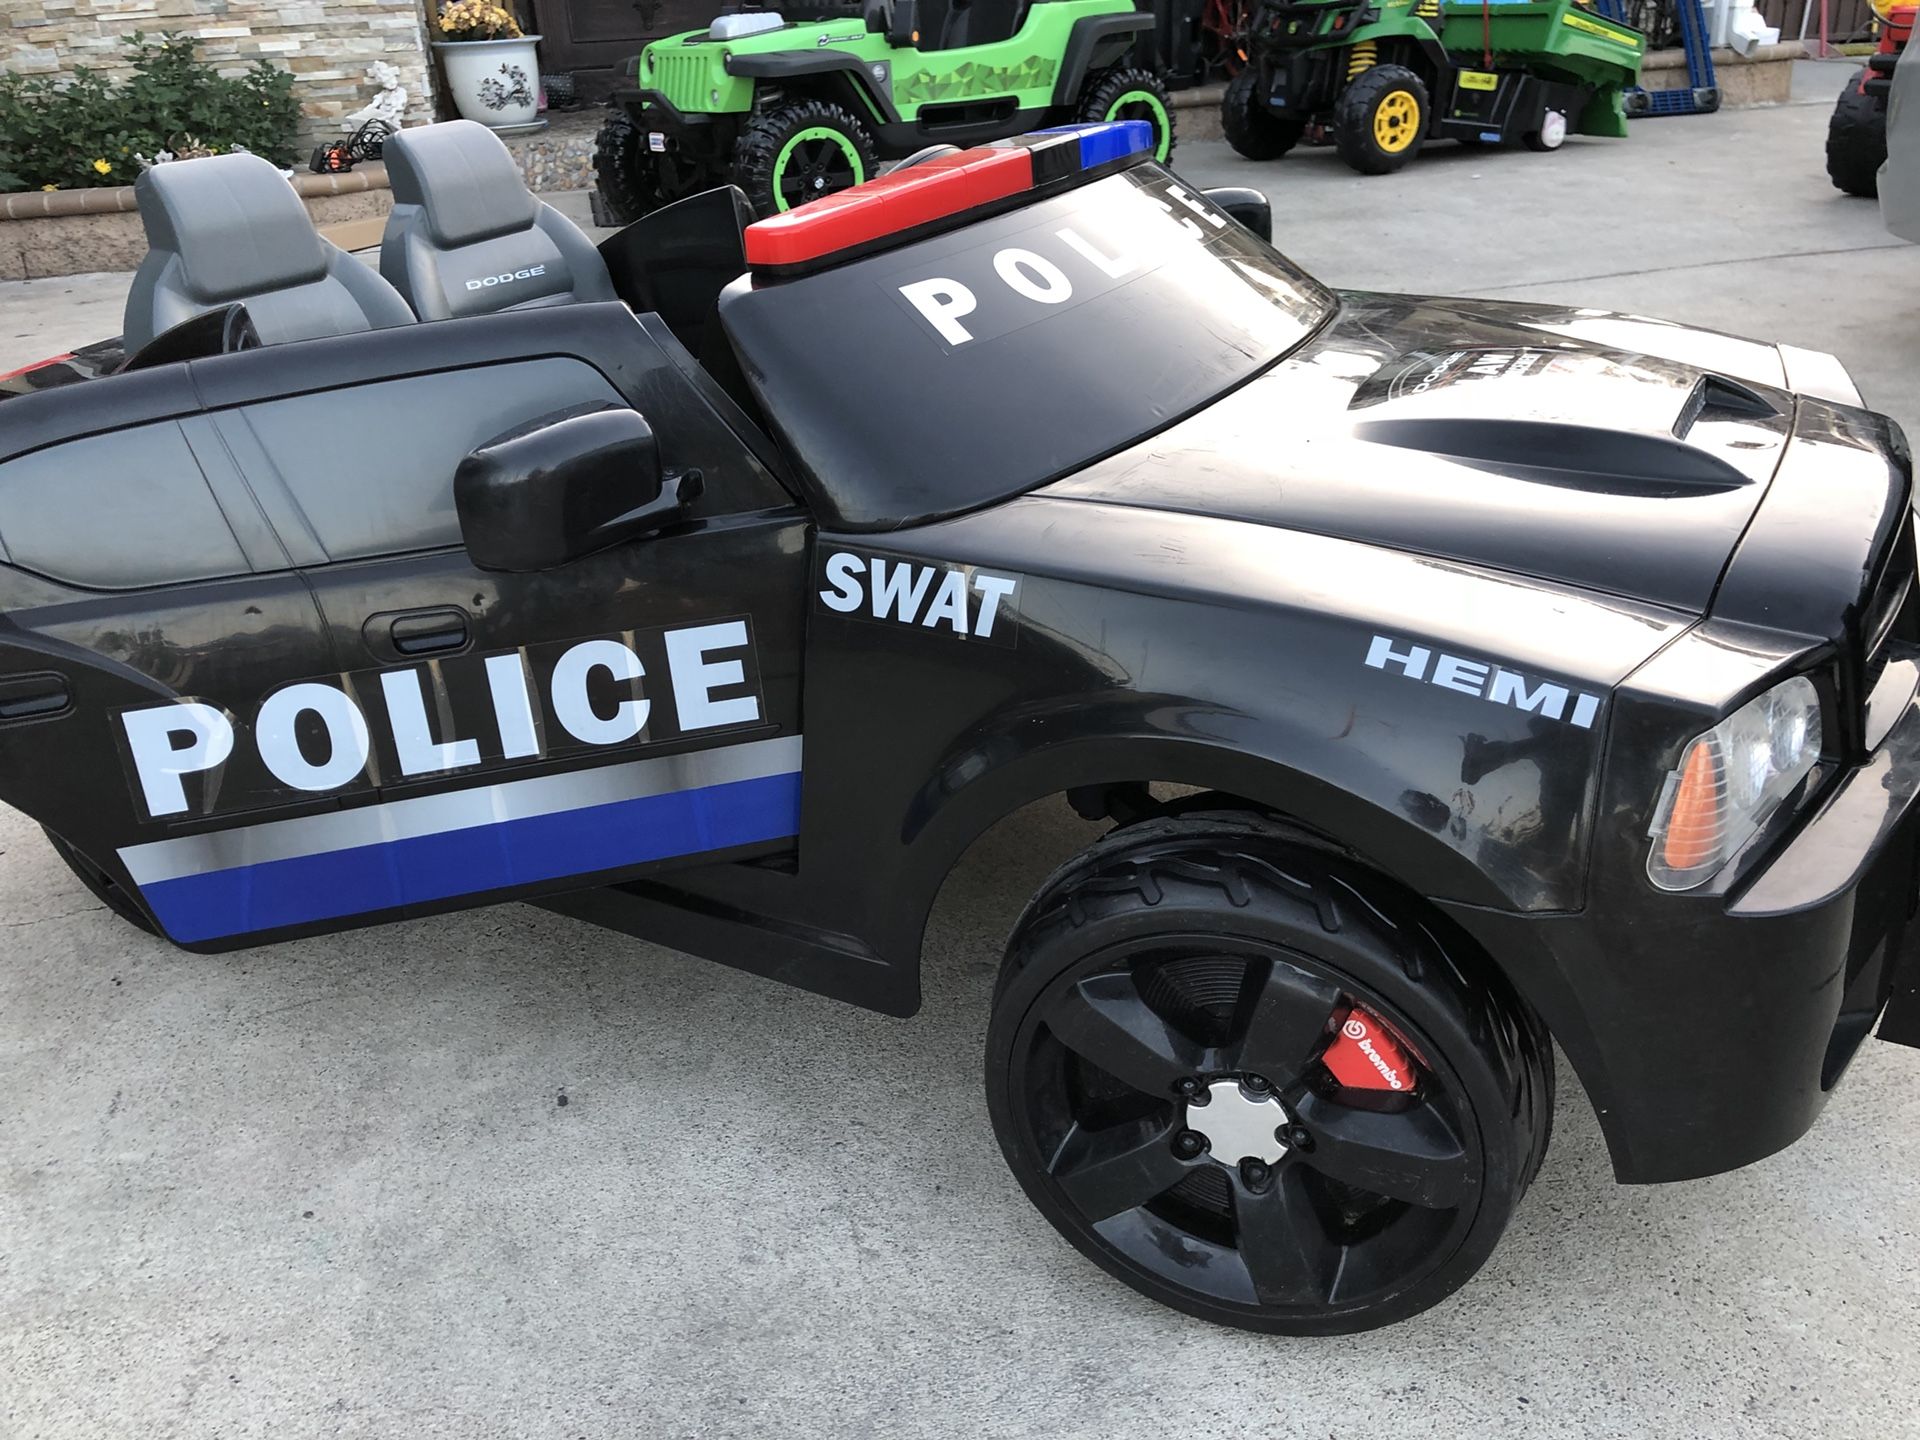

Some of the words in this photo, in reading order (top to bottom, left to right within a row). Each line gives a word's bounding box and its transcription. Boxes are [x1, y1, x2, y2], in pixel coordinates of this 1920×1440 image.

[465, 264, 546, 291] DODGE
[898, 185, 1227, 346] POLE
[1411, 351, 1467, 394] DODGE
[819, 552, 1017, 638] SWAT
[121, 620, 760, 817] POLICE
[1364, 635, 1600, 729] HEMI
[1357, 1038, 1402, 1090] brembo
